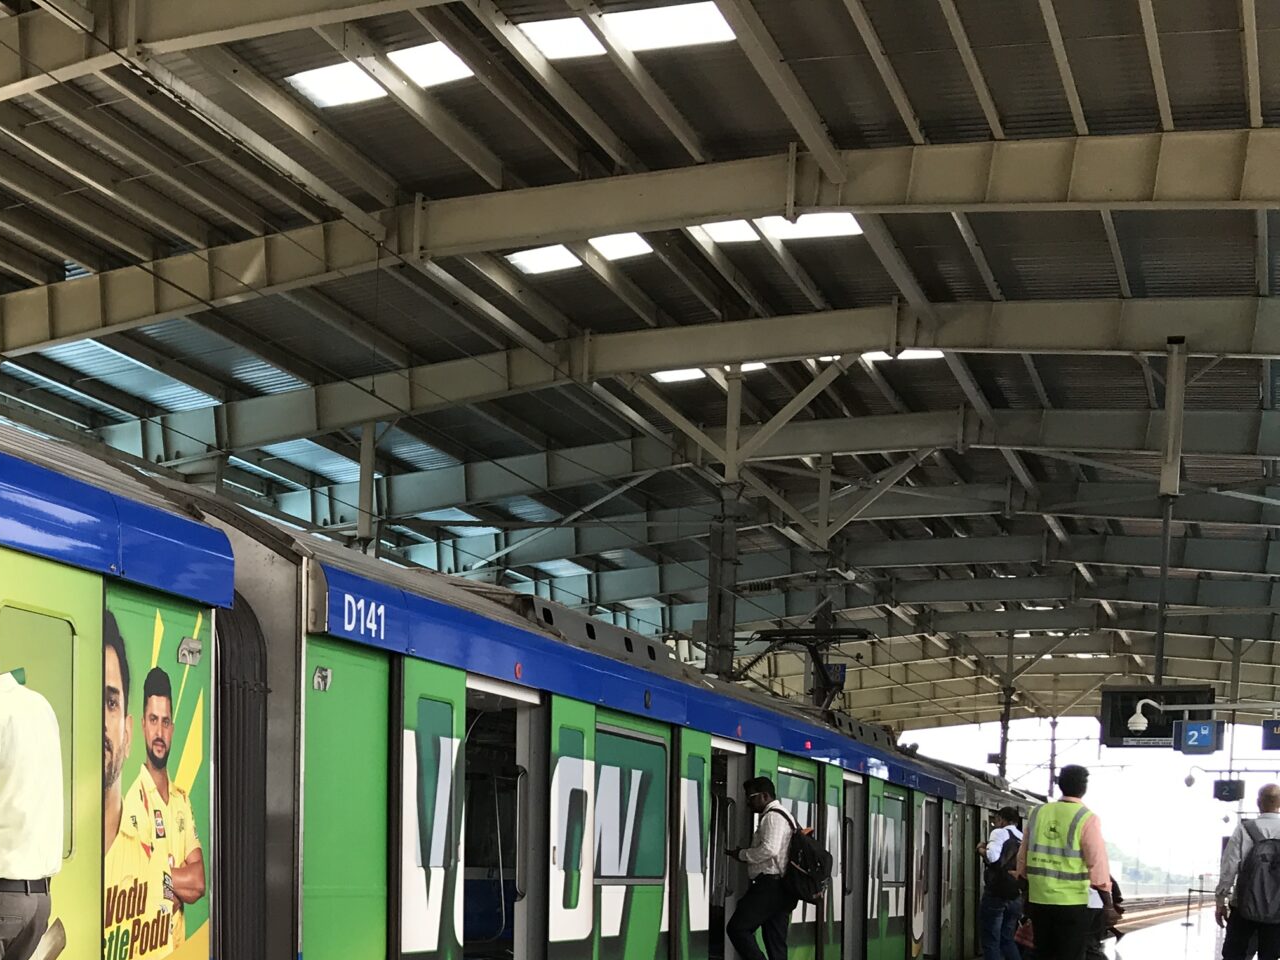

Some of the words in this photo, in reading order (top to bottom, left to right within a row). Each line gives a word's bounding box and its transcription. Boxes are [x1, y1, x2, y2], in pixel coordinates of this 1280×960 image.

[344, 594, 385, 640] D141
[1188, 731, 1199, 745] 2
[105, 878, 148, 928] Vodu
